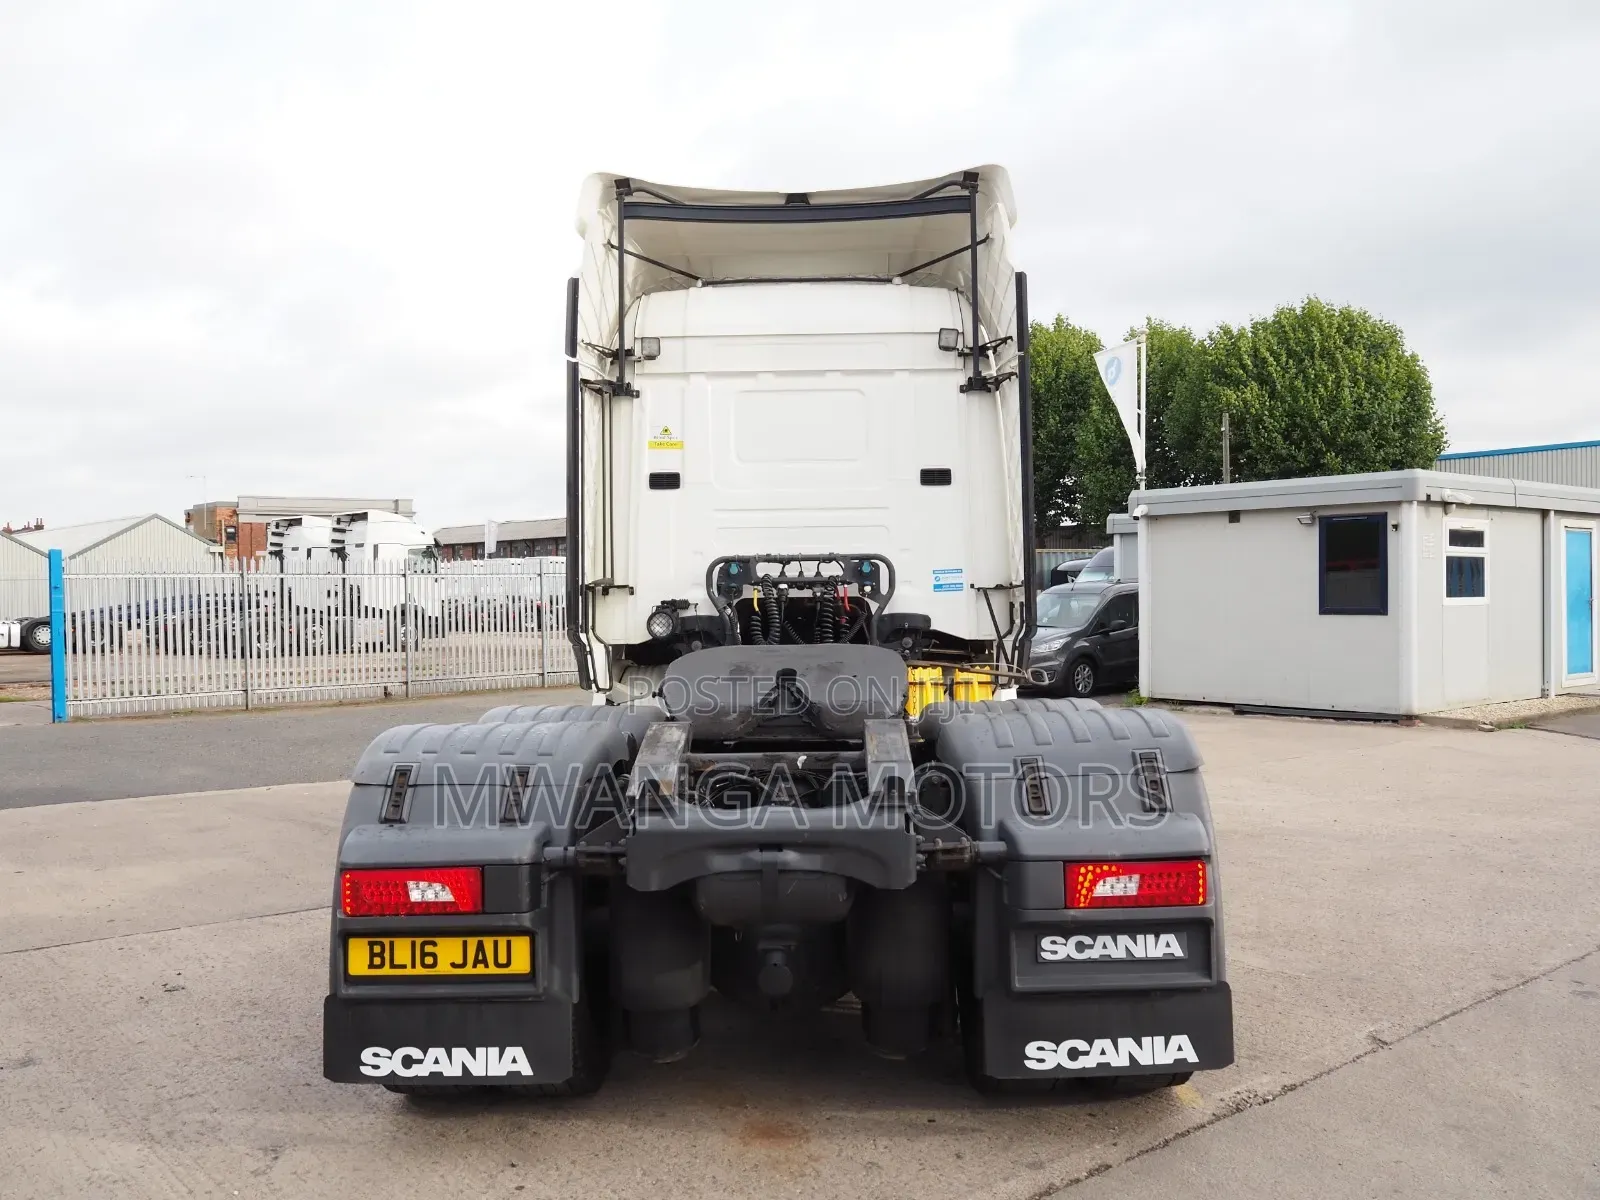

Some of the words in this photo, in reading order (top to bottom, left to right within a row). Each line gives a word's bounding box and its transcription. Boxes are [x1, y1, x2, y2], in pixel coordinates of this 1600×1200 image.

[367, 940, 438, 970] BL16
[449, 940, 512, 969] JAU
[1040, 933, 1185, 961] SCANIA
[359, 1046, 534, 1077] SCANIA
[1024, 1034, 1200, 1071] SCANIA
